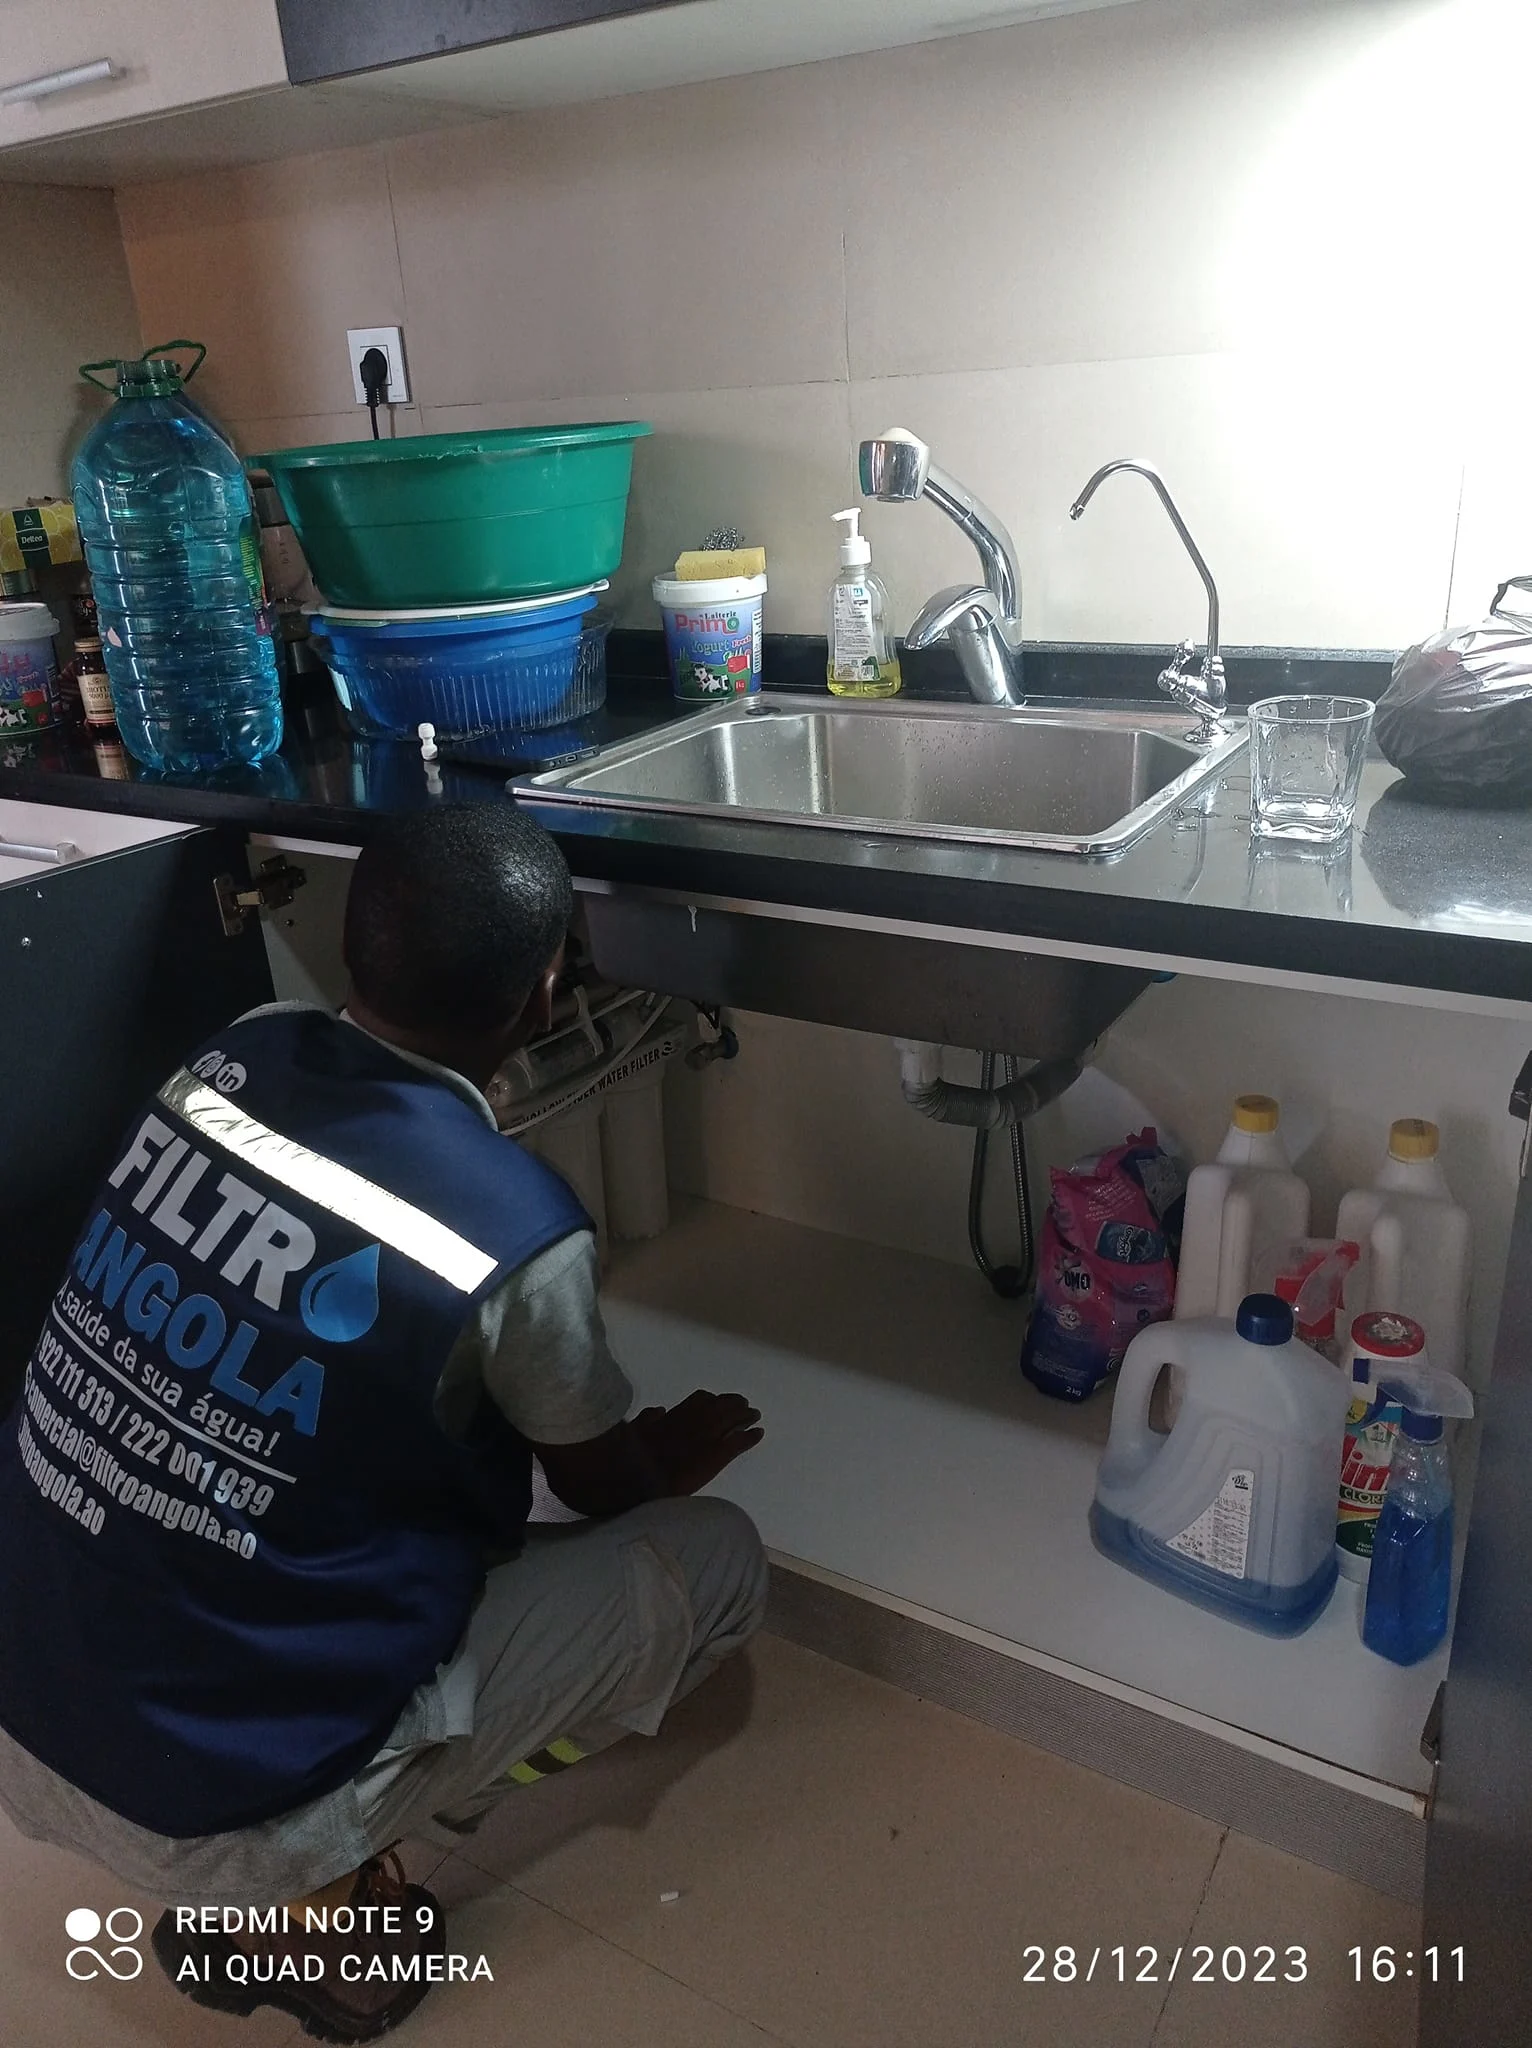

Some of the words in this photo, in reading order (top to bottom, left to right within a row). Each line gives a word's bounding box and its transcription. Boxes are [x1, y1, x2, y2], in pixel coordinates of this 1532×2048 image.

[597, 1065, 630, 1091] WATER
[630, 1049, 661, 1073] FILTER
[1064, 1270, 1091, 1291] OMO
[73, 1208, 326, 1437] ANGOLA
[37, 1330, 62, 1380] 922
[55, 1352, 86, 1401] 711
[62, 1289, 111, 1348] saúde
[113, 1336, 138, 1374] da
[142, 1363, 181, 1409] sua
[190, 1391, 281, 1458] água!
[77, 1376, 116, 1428] 313
[108, 1403, 130, 1436] /
[114, 1411, 173, 1465] 222
[27, 1377, 258, 1561] comercial@filtroangola.ao
[213, 1470, 275, 1517] 939
